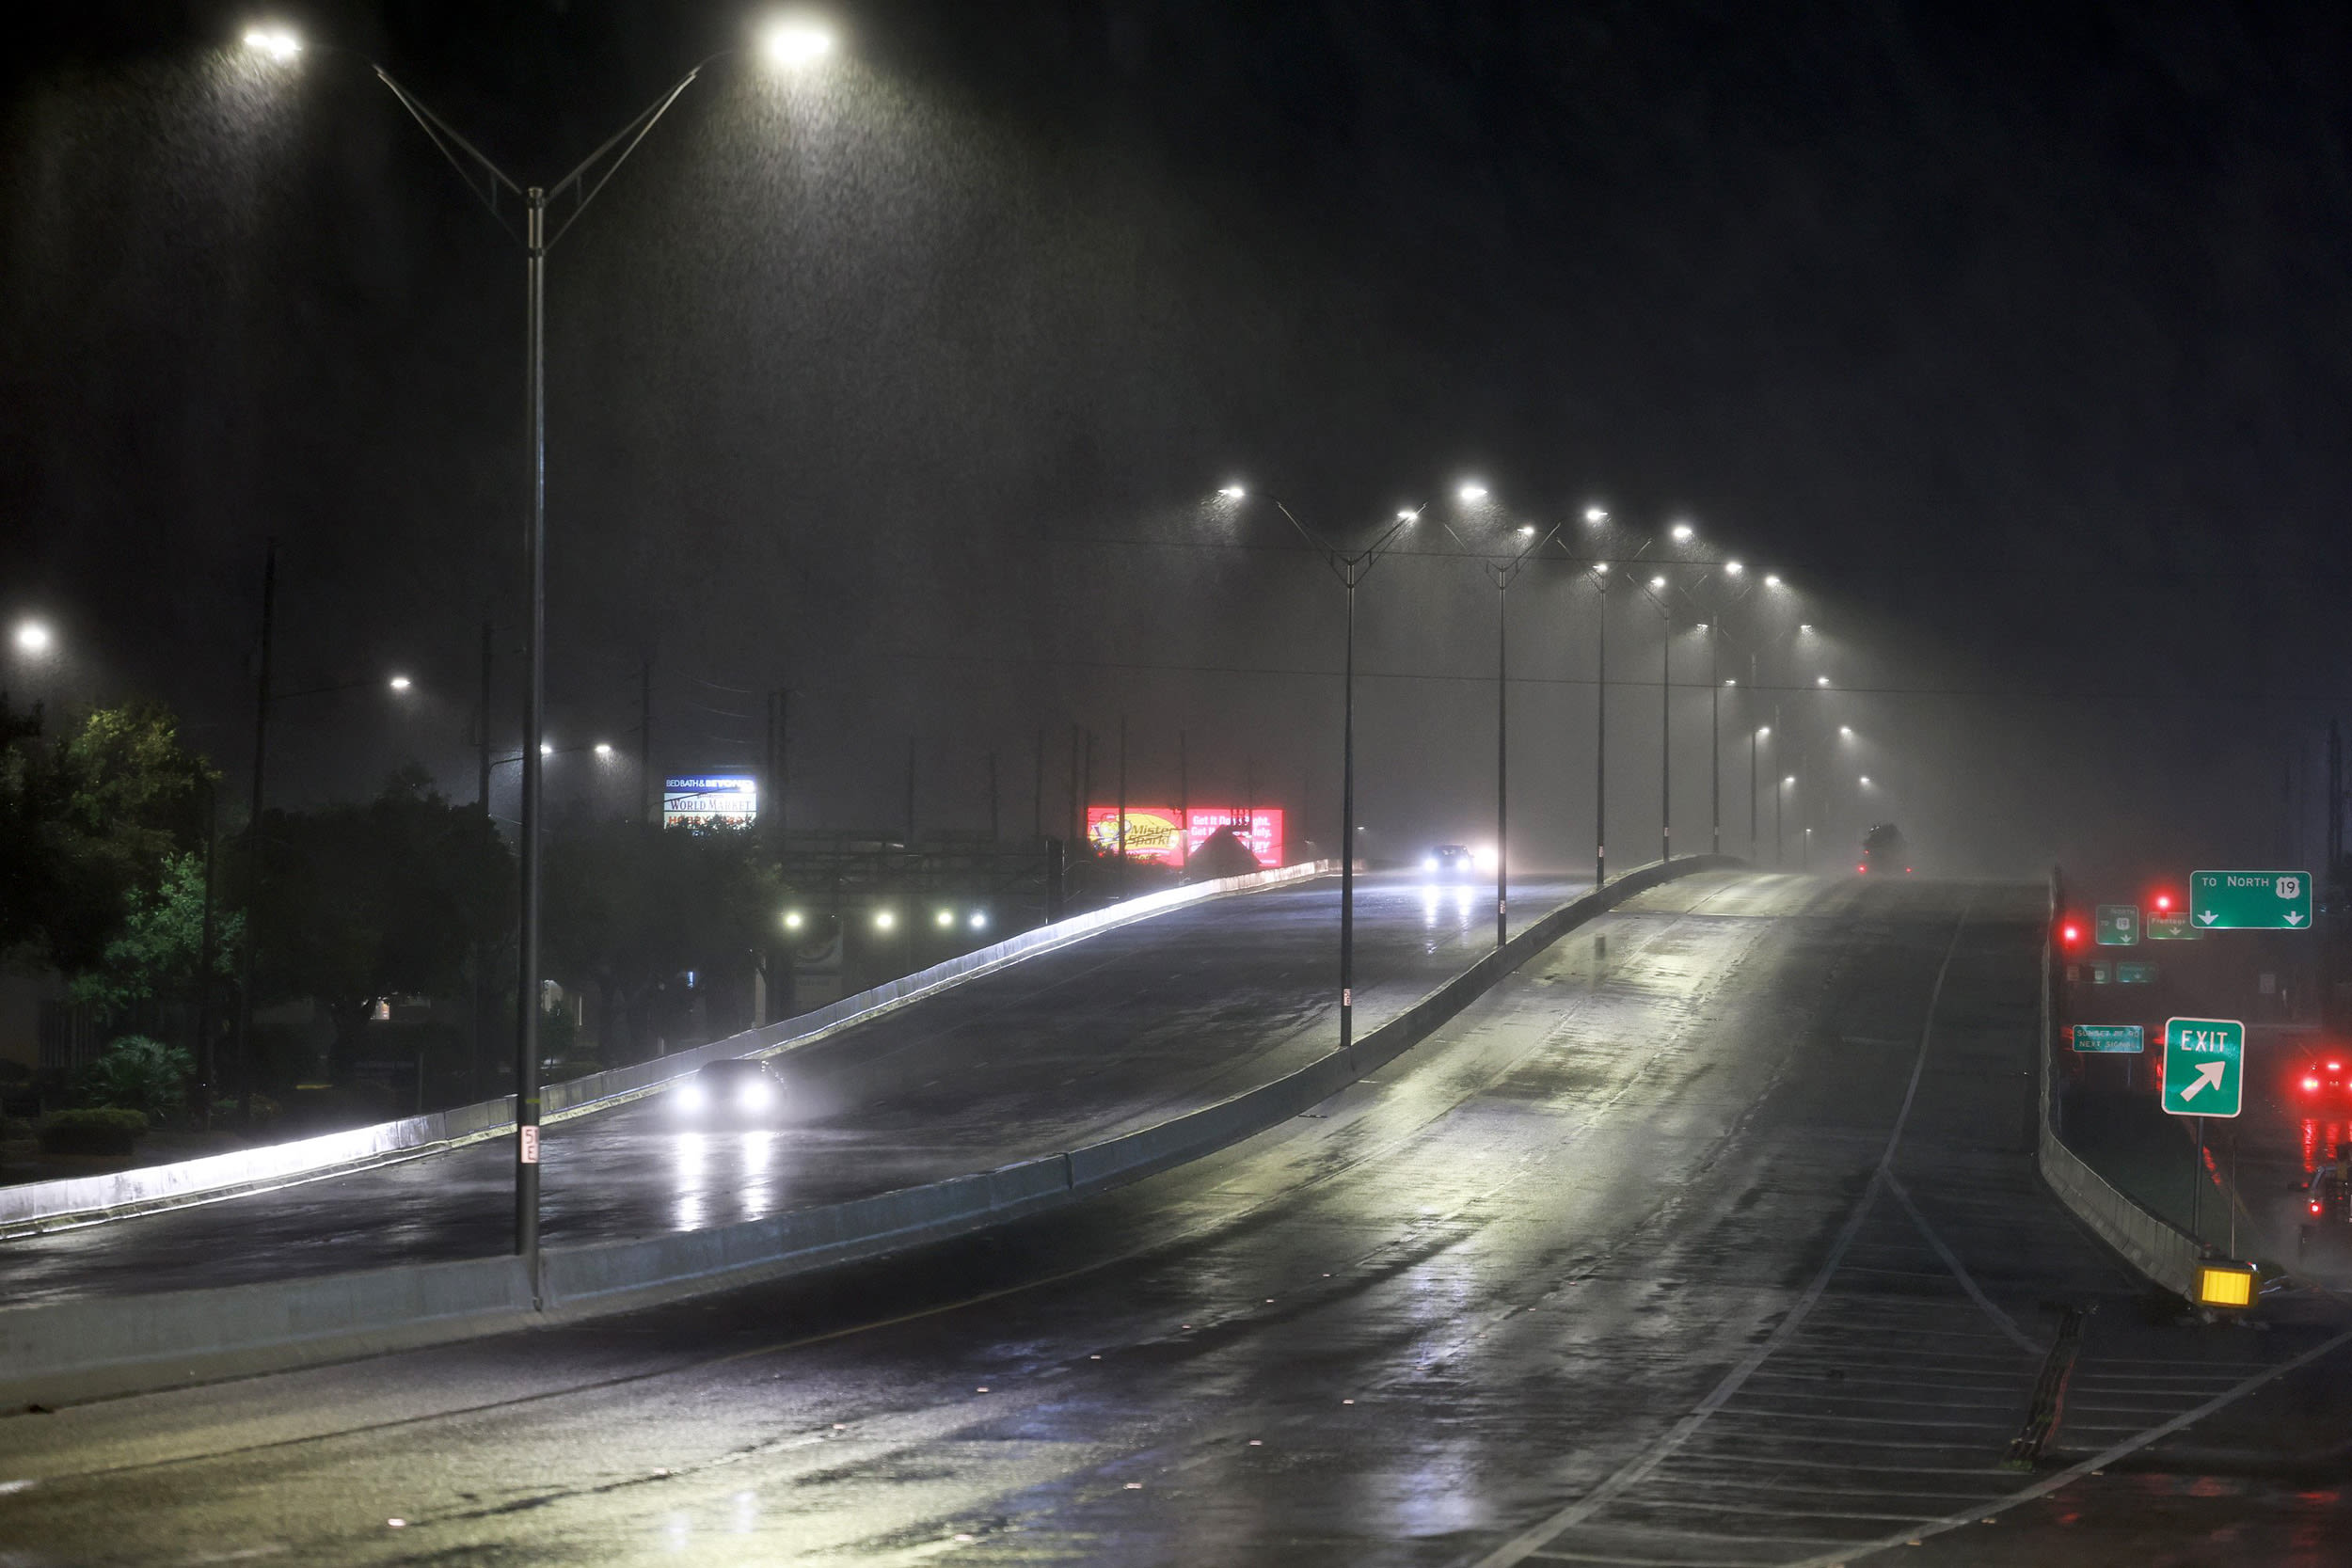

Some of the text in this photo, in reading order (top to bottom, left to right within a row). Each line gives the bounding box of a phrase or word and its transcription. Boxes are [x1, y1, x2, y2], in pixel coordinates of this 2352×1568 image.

[665, 779, 679, 787] BED
[680, 779, 698, 787] BATH
[699, 779, 706, 787] &
[670, 799, 752, 811] WORLD MARKET
[1192, 816, 1208, 826] Get
[1131, 825, 1172, 835] Mister
[2201, 876, 2296, 895] TO NORTH 19
[2181, 1030, 2228, 1052] EXIT
